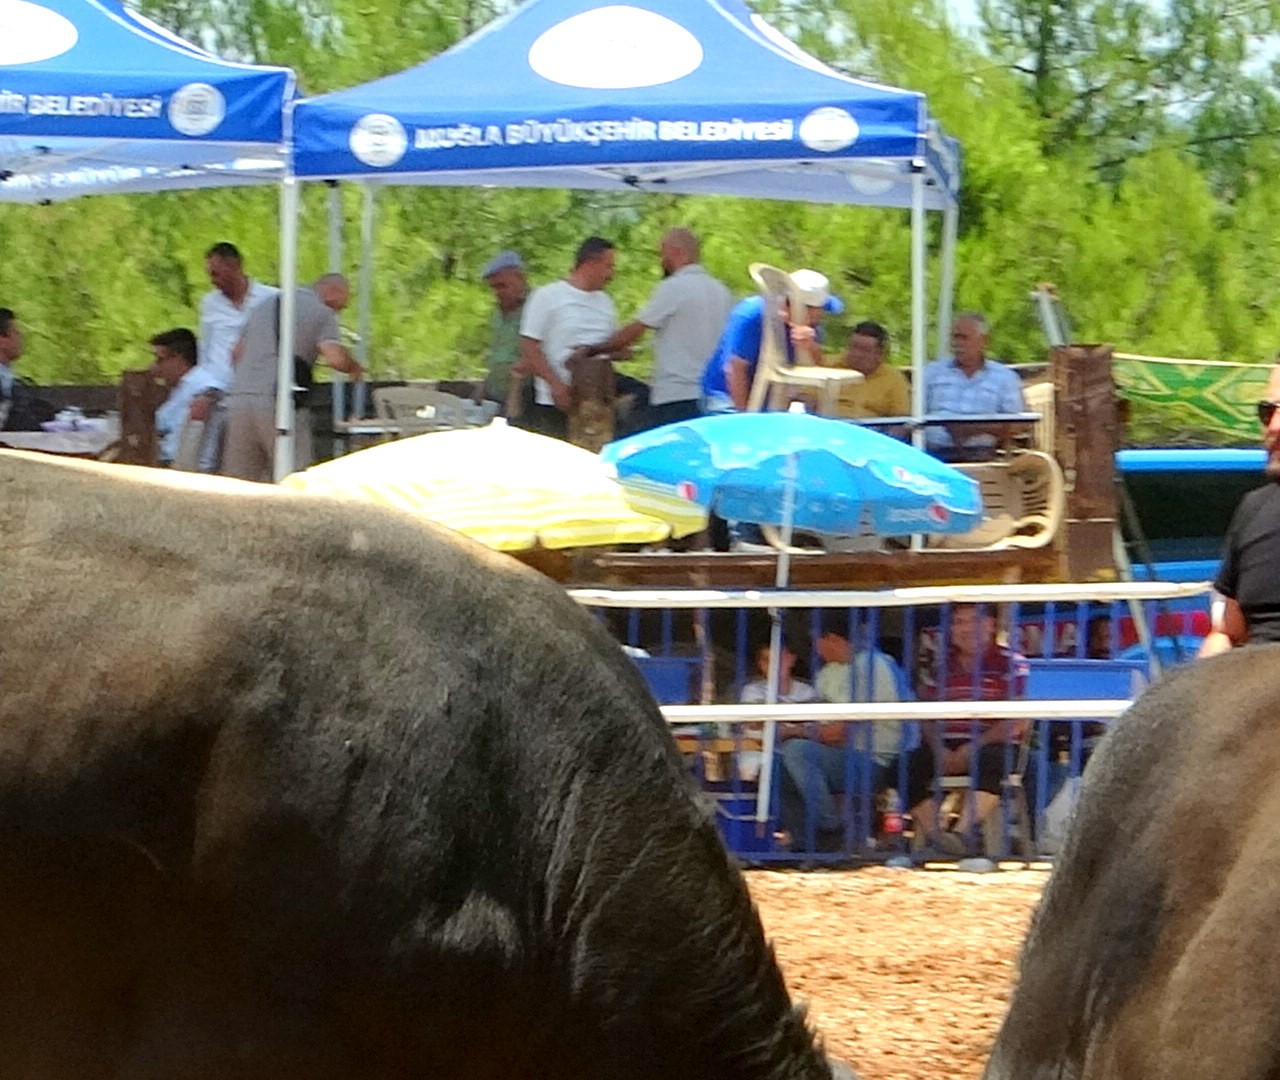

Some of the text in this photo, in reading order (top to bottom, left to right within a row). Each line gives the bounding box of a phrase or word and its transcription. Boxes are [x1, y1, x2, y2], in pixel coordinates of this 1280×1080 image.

[28, 92, 162, 118] BELEDİYESİ
[505, 117, 656, 147] BÜYÜKŞEHİR
[658, 118, 794, 141] BELEDİYESİ
